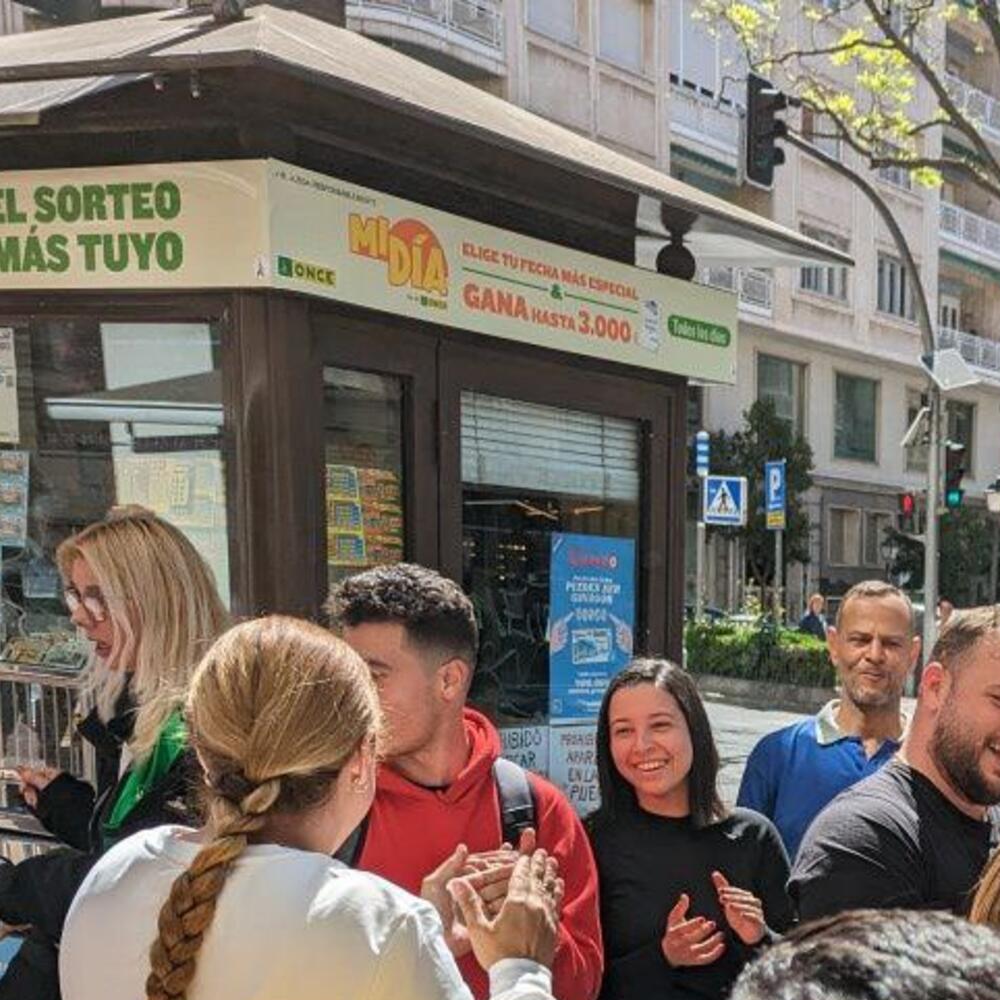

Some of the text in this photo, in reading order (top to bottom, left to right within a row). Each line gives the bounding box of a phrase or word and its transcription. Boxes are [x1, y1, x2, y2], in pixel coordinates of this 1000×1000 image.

[34, 180, 182, 222] SORTEO
[77, 230, 184, 273] TUYO
[348, 212, 390, 262] MI
[294, 264, 336, 287] ONCE
[388, 232, 448, 297] DÍA
[462, 242, 500, 264] ELIGE
[502, 250, 518, 270] TU
[520, 258, 559, 280] FECHA
[588, 276, 639, 301] ESPECIAL
[463, 283, 529, 321] GANA
[531, 307, 576, 332] HASTA
[578, 306, 632, 342] 3.000
[551, 283, 563, 301] &
